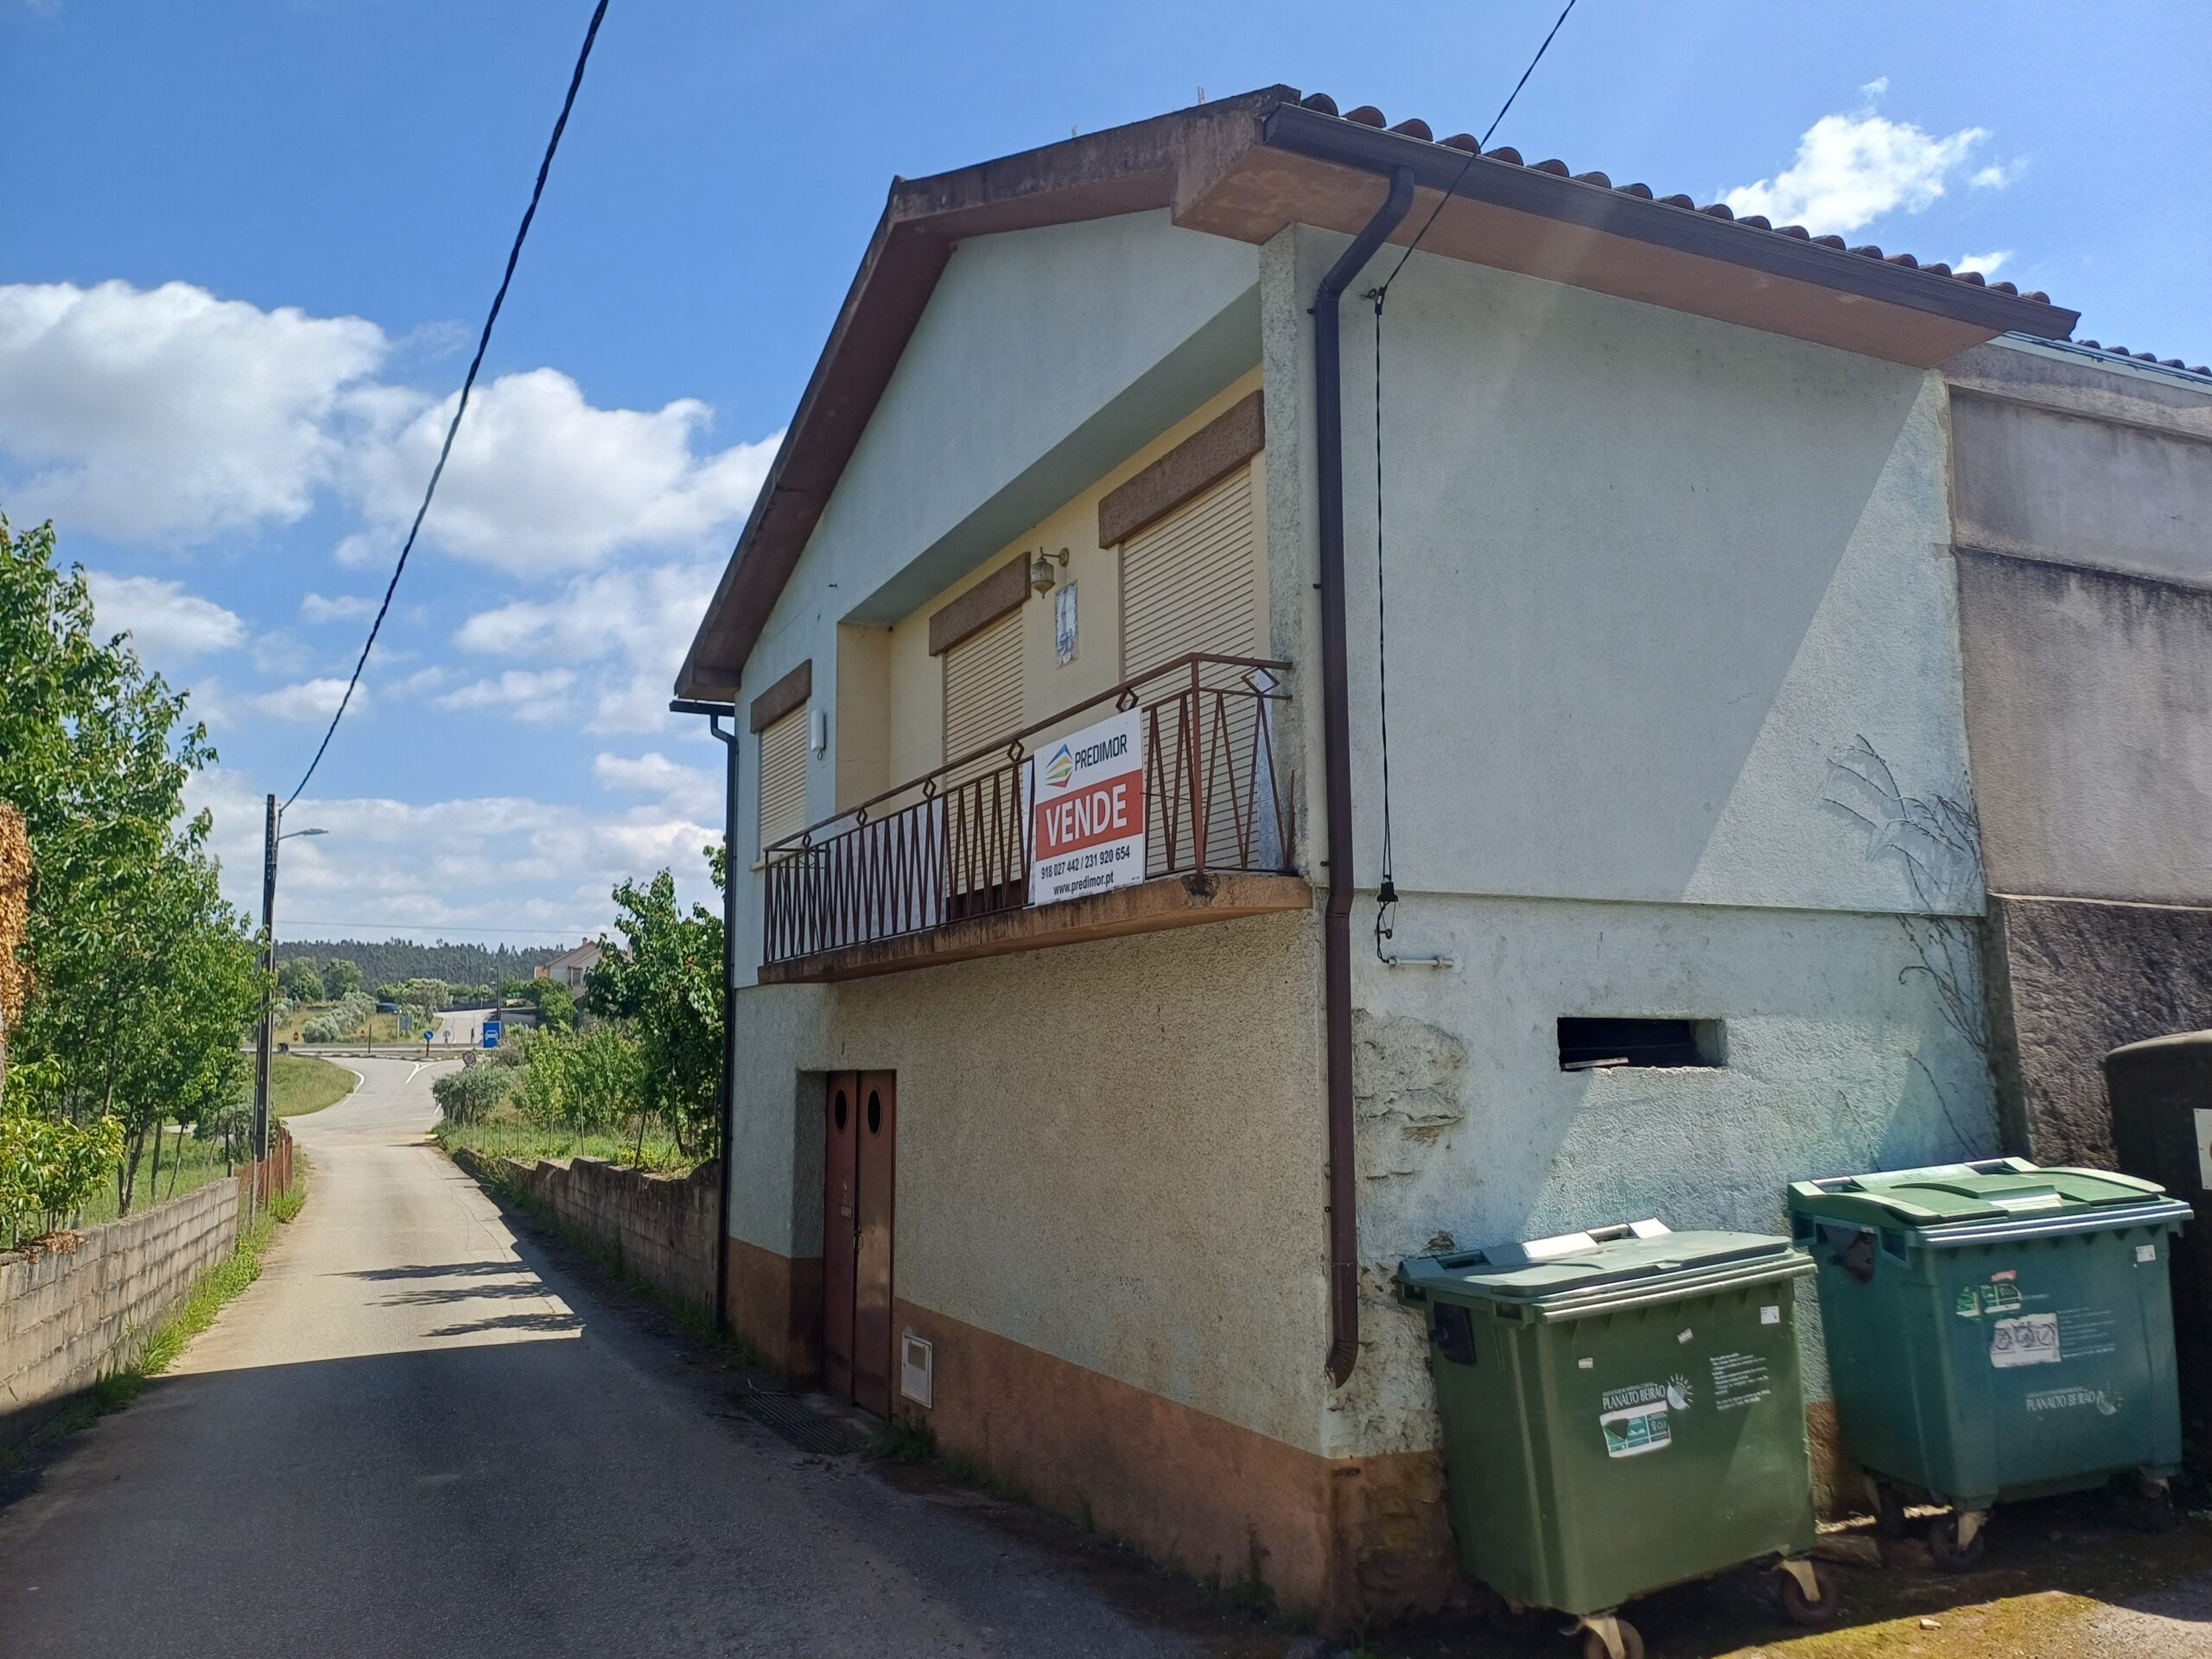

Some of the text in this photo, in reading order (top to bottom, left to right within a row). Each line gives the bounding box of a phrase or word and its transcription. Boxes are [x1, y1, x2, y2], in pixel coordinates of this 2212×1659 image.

[1074, 734, 1128, 772] PREDIMOR
[1046, 783, 1128, 847] VENDE
[1041, 865, 1052, 880] 918
[1054, 861, 1065, 876] 027
[1067, 858, 1079, 873] 442
[1085, 853, 1097, 868] 231
[1100, 849, 1113, 865] 920
[1116, 845, 1130, 861] 654
[1053, 870, 1114, 895] www.predimor.pt
[1602, 1390, 1639, 1410] PLANALTO
